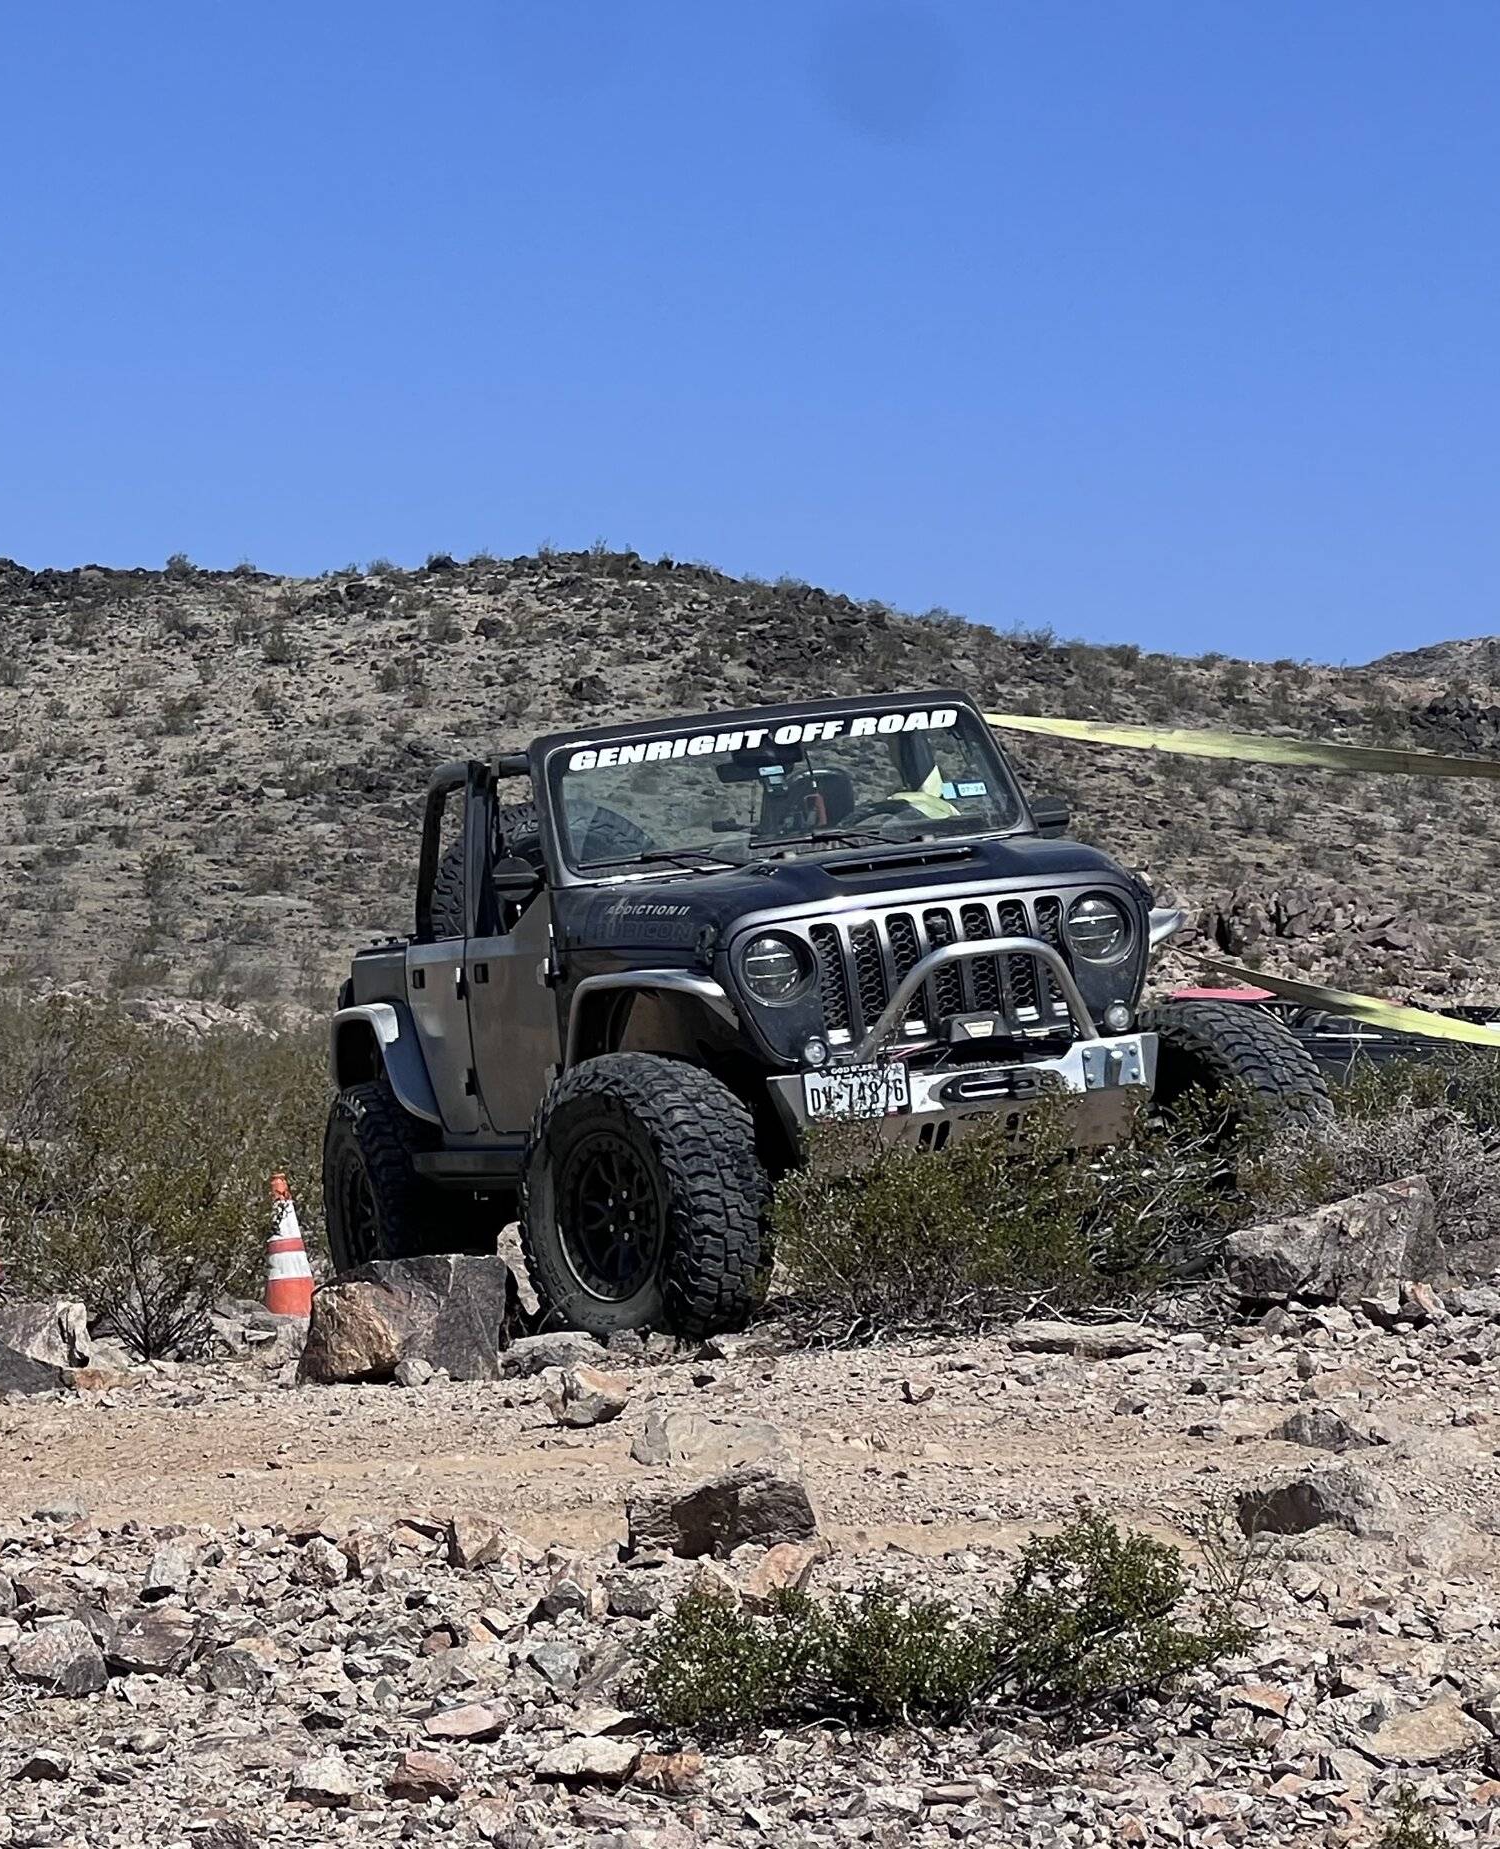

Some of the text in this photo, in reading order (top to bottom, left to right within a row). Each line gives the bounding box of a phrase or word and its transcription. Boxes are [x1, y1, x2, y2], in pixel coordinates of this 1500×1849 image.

[568, 709, 958, 772] GENRIGHT OFF ROAD
[604, 904, 679, 916] ADDICTION
[830, 1065, 850, 1076] GOD
